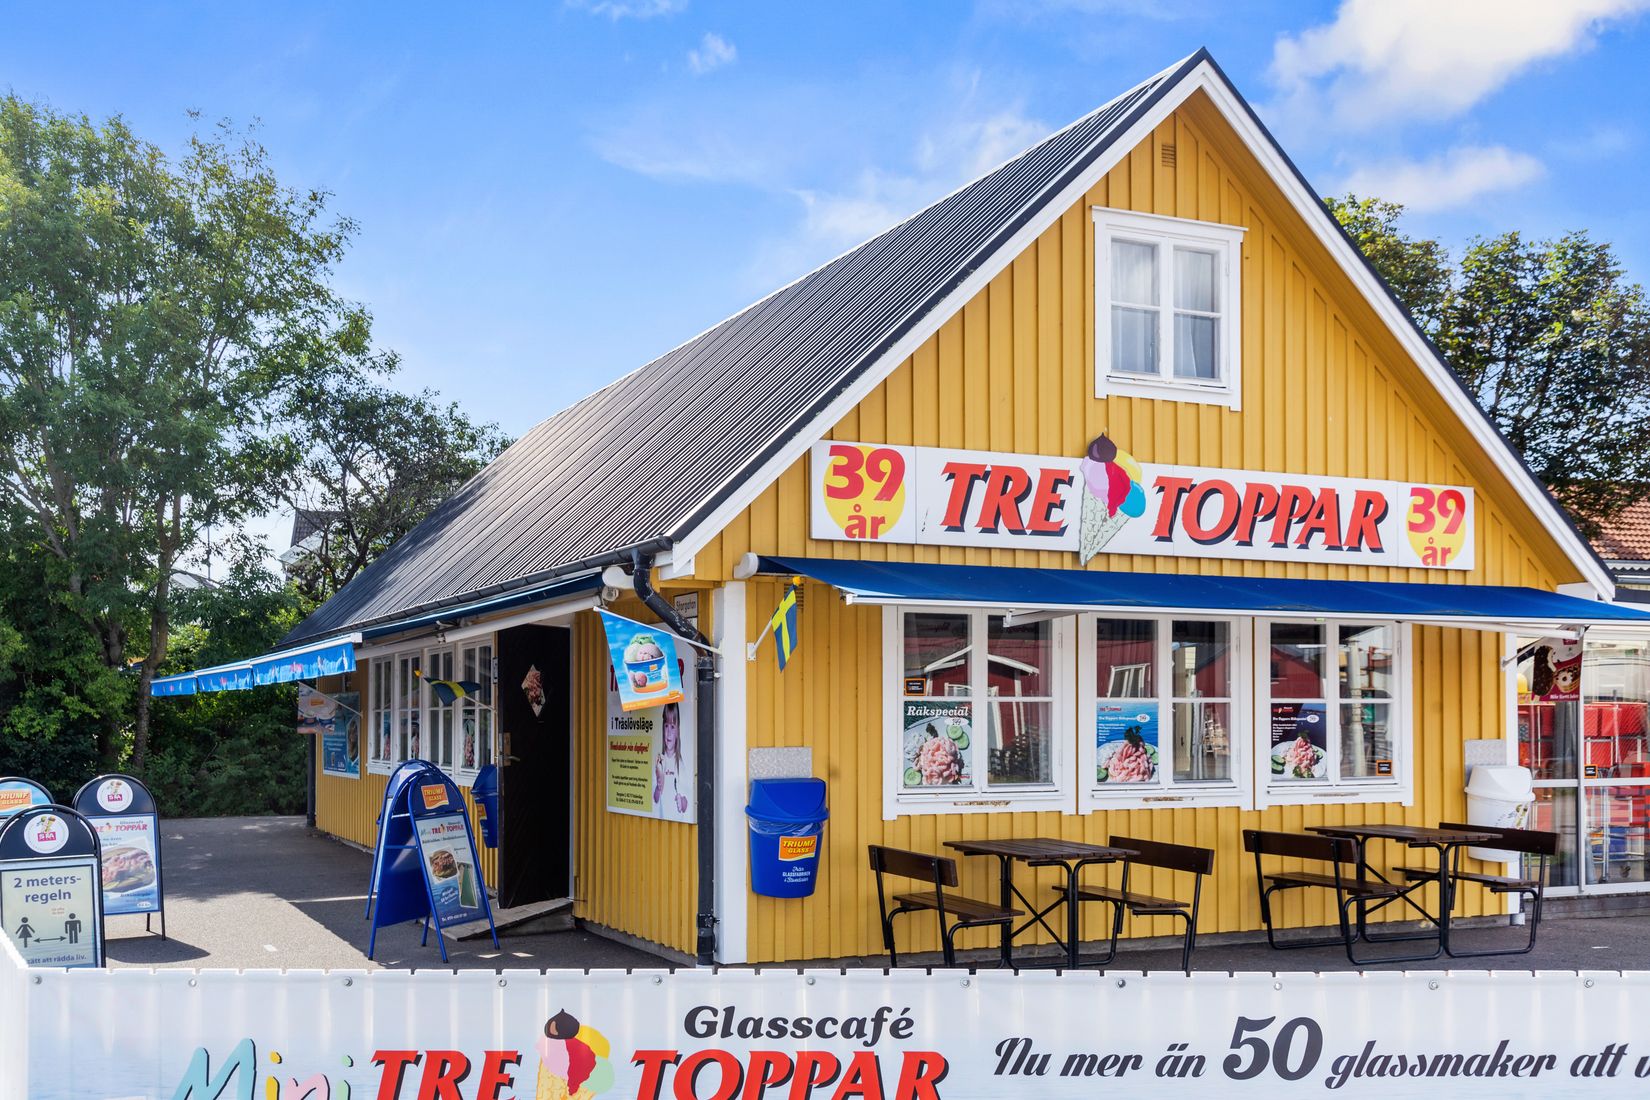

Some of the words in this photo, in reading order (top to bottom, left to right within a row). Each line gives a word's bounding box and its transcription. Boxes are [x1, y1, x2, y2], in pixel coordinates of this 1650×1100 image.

[826, 445, 906, 502] 39
[940, 462, 1074, 537] TRE
[1151, 476, 1389, 553] TOPPAR
[1408, 487, 1466, 535] 39
[844, 504, 886, 540] år
[1422, 537, 1452, 567] år
[907, 706, 969, 718] Räkspecial
[615, 716, 653, 733] Träslövsläge
[115, 824, 148, 832] TOPPAR
[783, 840, 814, 848] TRIUMF
[14, 878, 22, 888] 2
[26, 875, 82, 887] meters-
[25, 889, 71, 904] regeln
[53, 955, 75, 963] rädda
[684, 1005, 915, 1047] Glasscafé
[994, 1037, 1052, 1076] Nu
[1059, 1052, 1144, 1077] mer
[1155, 1042, 1206, 1078] än
[1222, 1015, 1323, 1081] 50
[1325, 1040, 1557, 1089] glassmaker
[1569, 1043, 1629, 1077] att
[370, 1050, 522, 1100] TRE
[629, 1049, 950, 1100] TOPPAR
